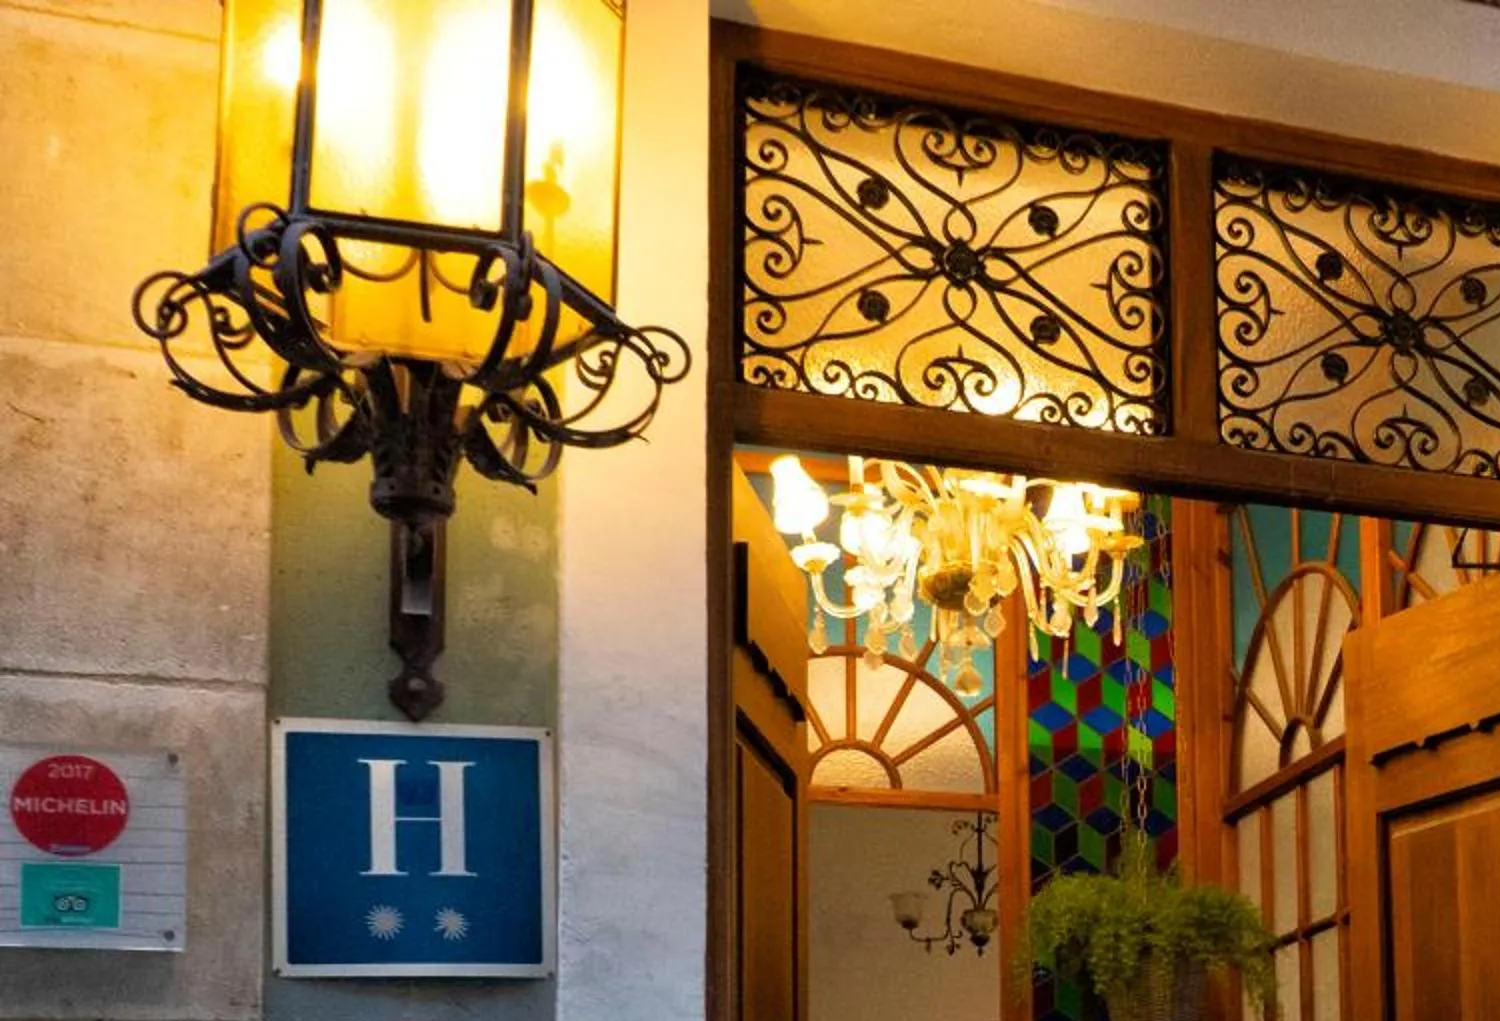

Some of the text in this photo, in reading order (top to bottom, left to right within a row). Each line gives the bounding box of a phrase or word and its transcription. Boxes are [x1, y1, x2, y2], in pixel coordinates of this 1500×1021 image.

[48, 763, 96, 780] 2017
[14, 796, 127, 815] MICHELIN
[357, 759, 478, 877] H
